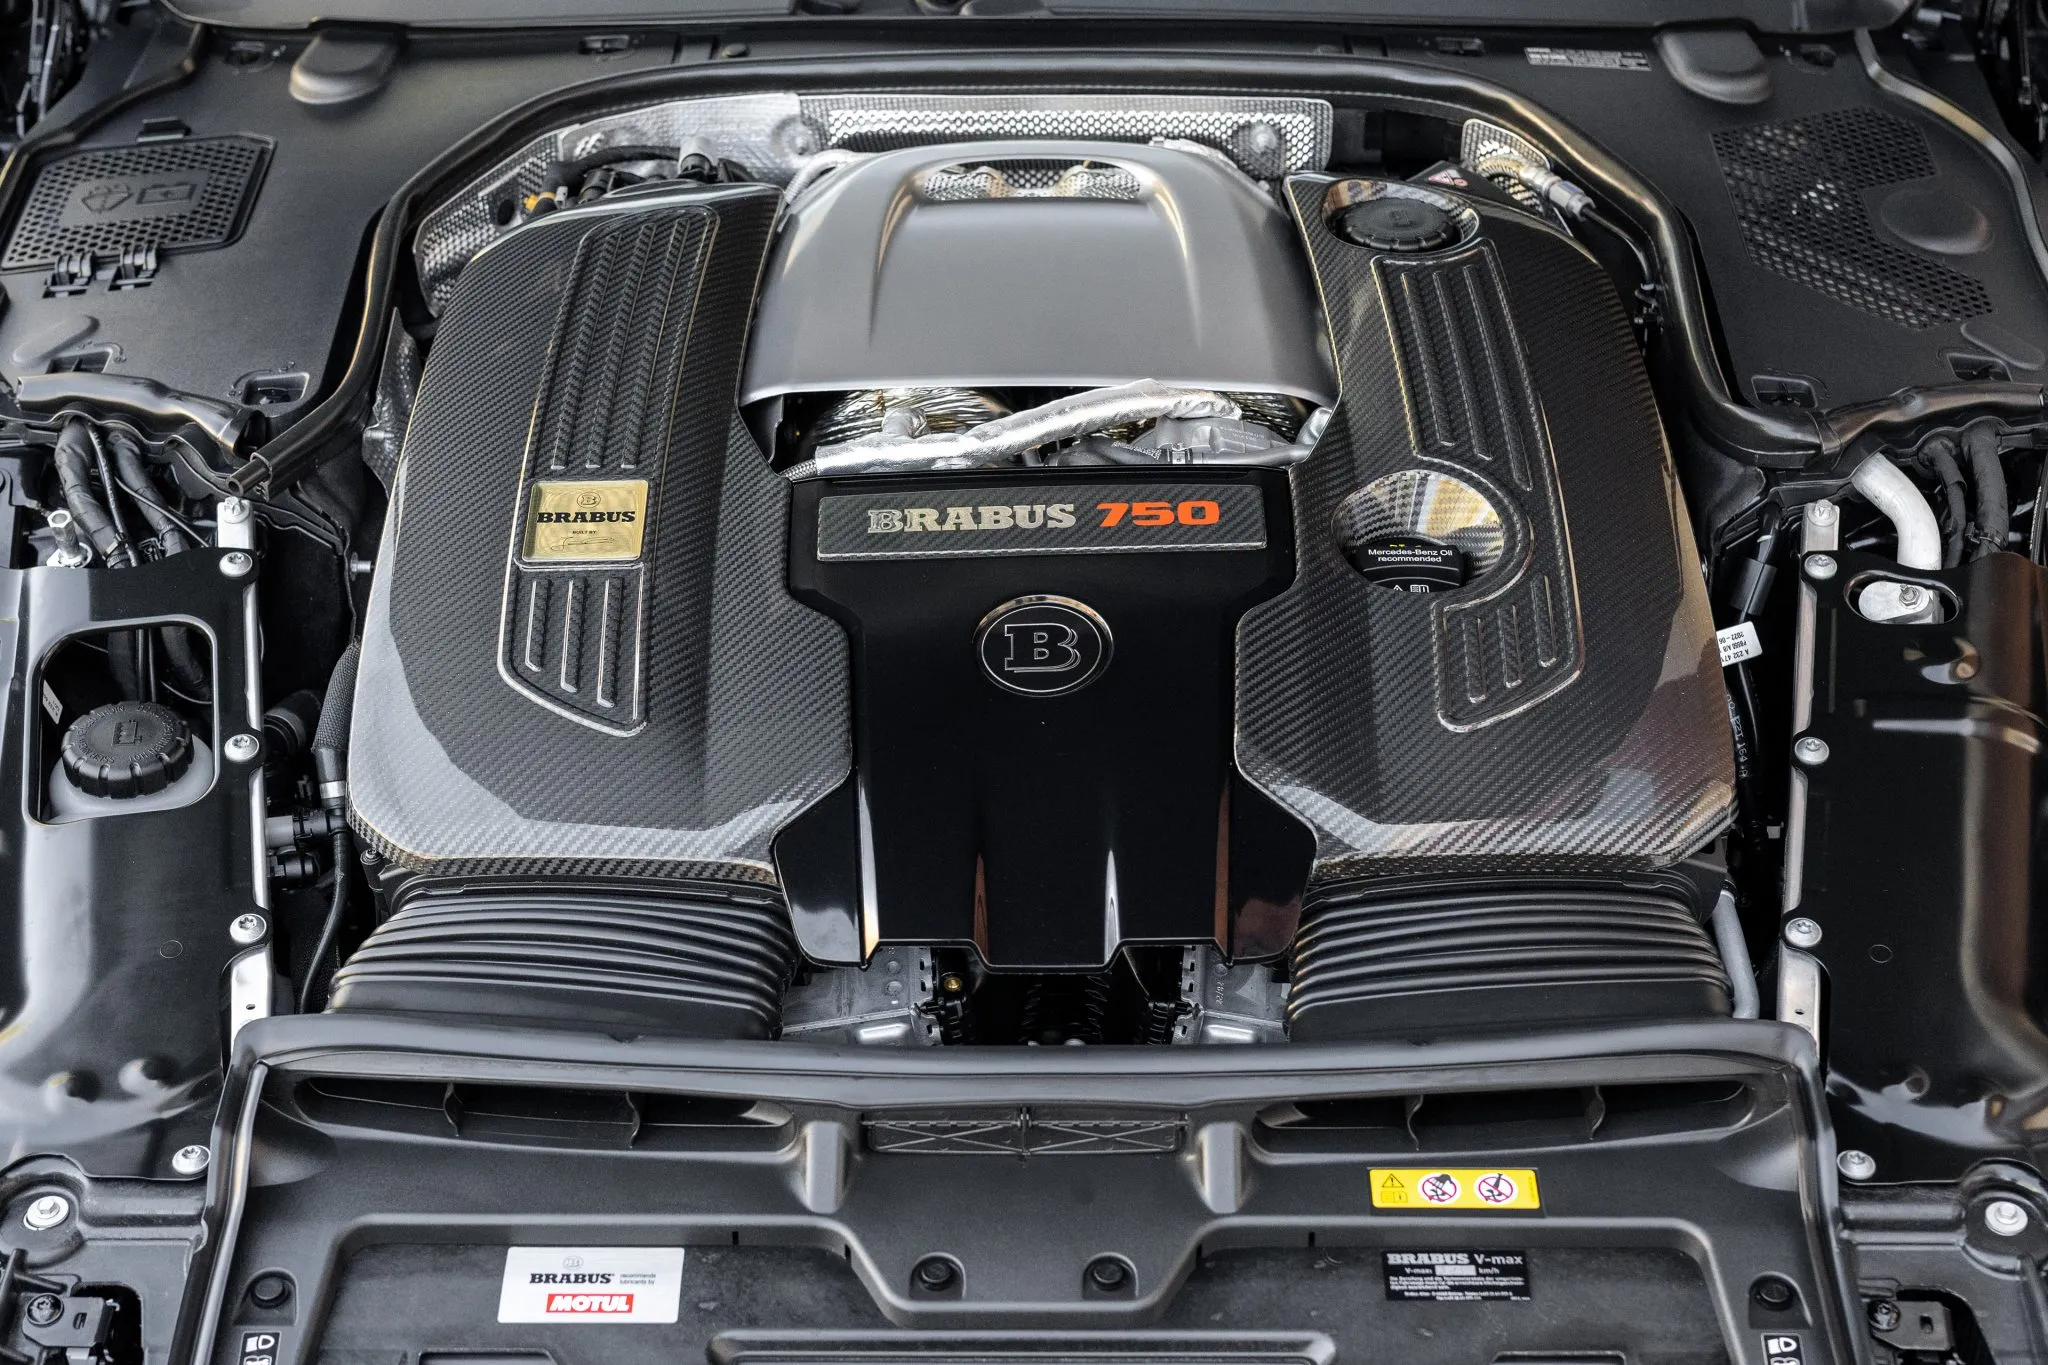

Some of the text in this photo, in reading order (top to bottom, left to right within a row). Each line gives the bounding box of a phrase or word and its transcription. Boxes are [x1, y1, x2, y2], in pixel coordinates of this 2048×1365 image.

[537, 511, 636, 523] BRABUS
[867, 500, 1220, 534] BRABUS 750
[1004, 622, 1082, 673] B
[1387, 1253, 1523, 1265] BRABUS V-max
[1478, 1267, 1500, 1275] km/h
[550, 1296, 629, 1312] MOTUL
